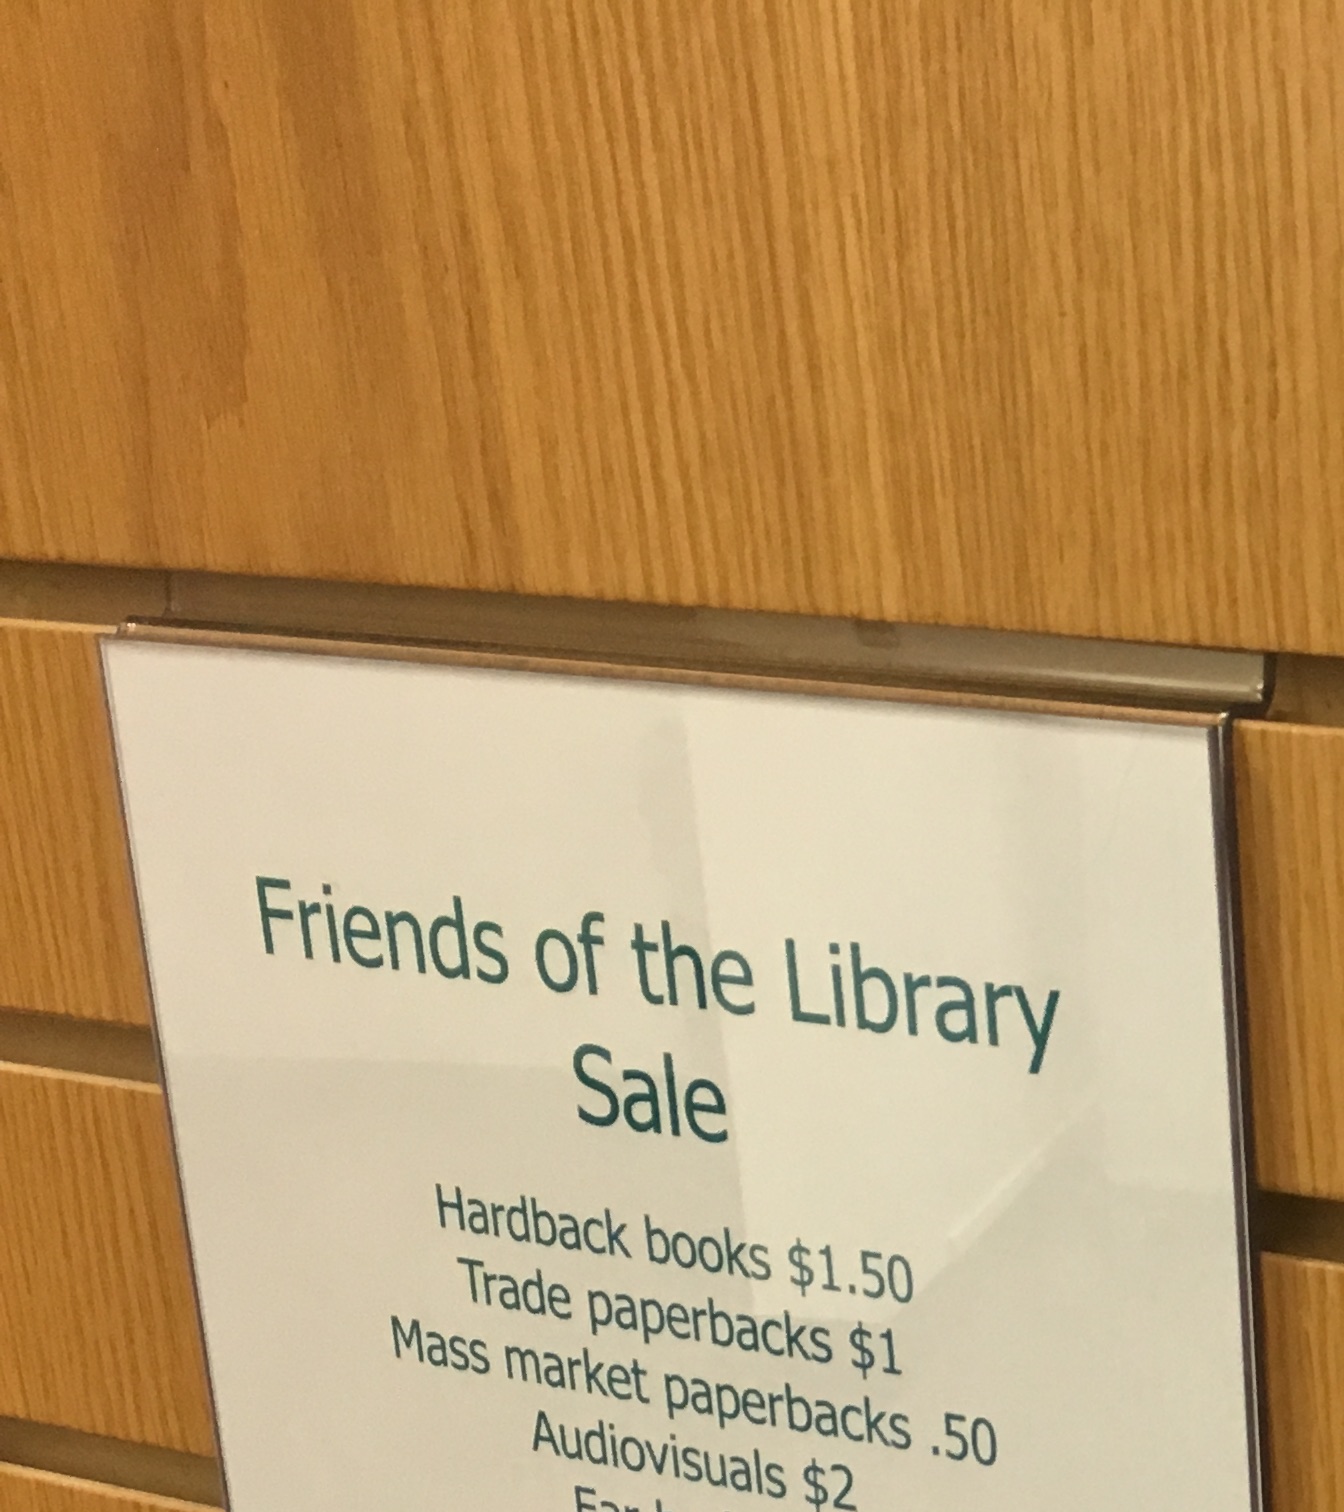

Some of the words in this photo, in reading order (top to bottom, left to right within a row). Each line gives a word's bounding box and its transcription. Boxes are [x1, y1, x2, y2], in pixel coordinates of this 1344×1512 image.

[256, 876, 509, 984] Friends
[535, 911, 605, 996] of
[630, 920, 755, 1016] the
[785, 938, 1061, 1075] Library
[573, 1044, 729, 1144] Sale
[435, 1183, 632, 1259] Hardback
[644, 1214, 771, 1280] books
[788, 1237, 913, 1303] $1.50
[456, 1257, 572, 1320] Trade
[588, 1290, 833, 1364] paperbacks
[849, 1321, 902, 1380] $1
[391, 1315, 490, 1375] Mass
[505, 1346, 650, 1404] market
[664, 1374, 912, 1450] paperbacks
[931, 1412, 997, 1466] .50
[532, 1410, 787, 1499] Audiovisuals
